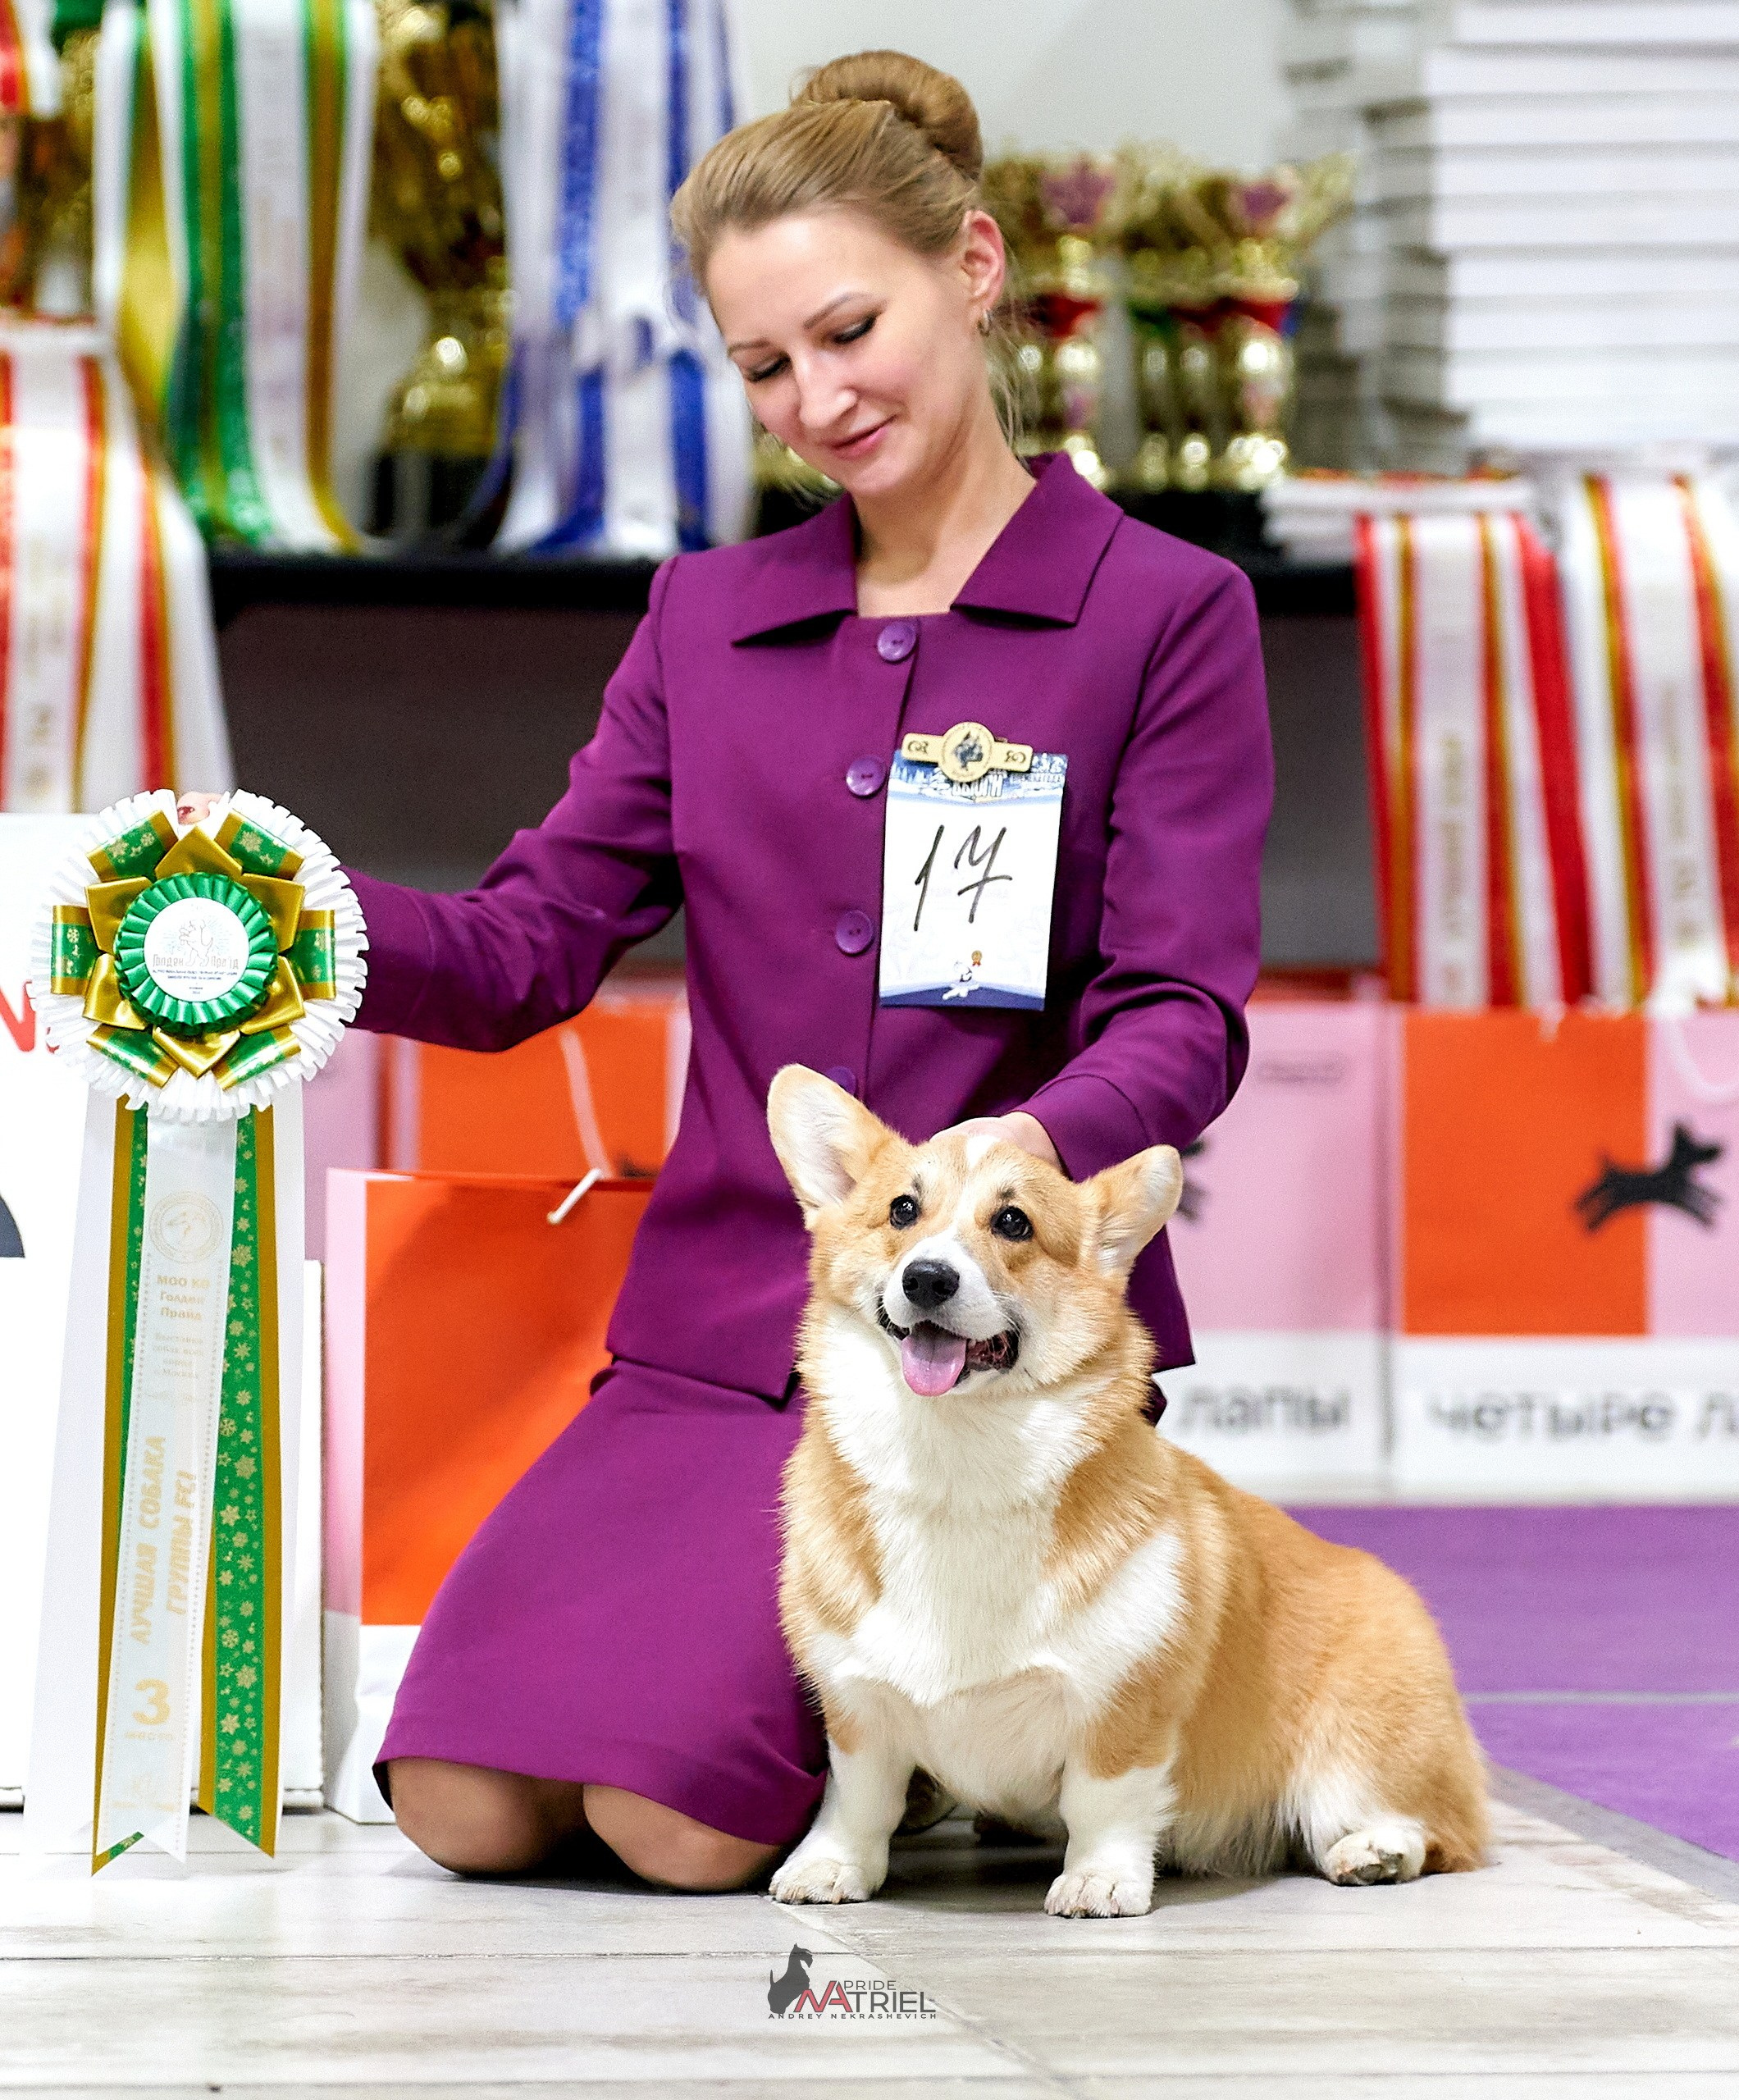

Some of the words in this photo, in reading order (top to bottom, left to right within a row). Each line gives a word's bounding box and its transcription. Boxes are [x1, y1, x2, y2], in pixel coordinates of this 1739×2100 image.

[914, 824, 1014, 932] 17
[138, 1436, 166, 1529] СОБАКА
[166, 1515, 192, 1615] ГРУППЫ
[132, 1678, 171, 1726] 3
